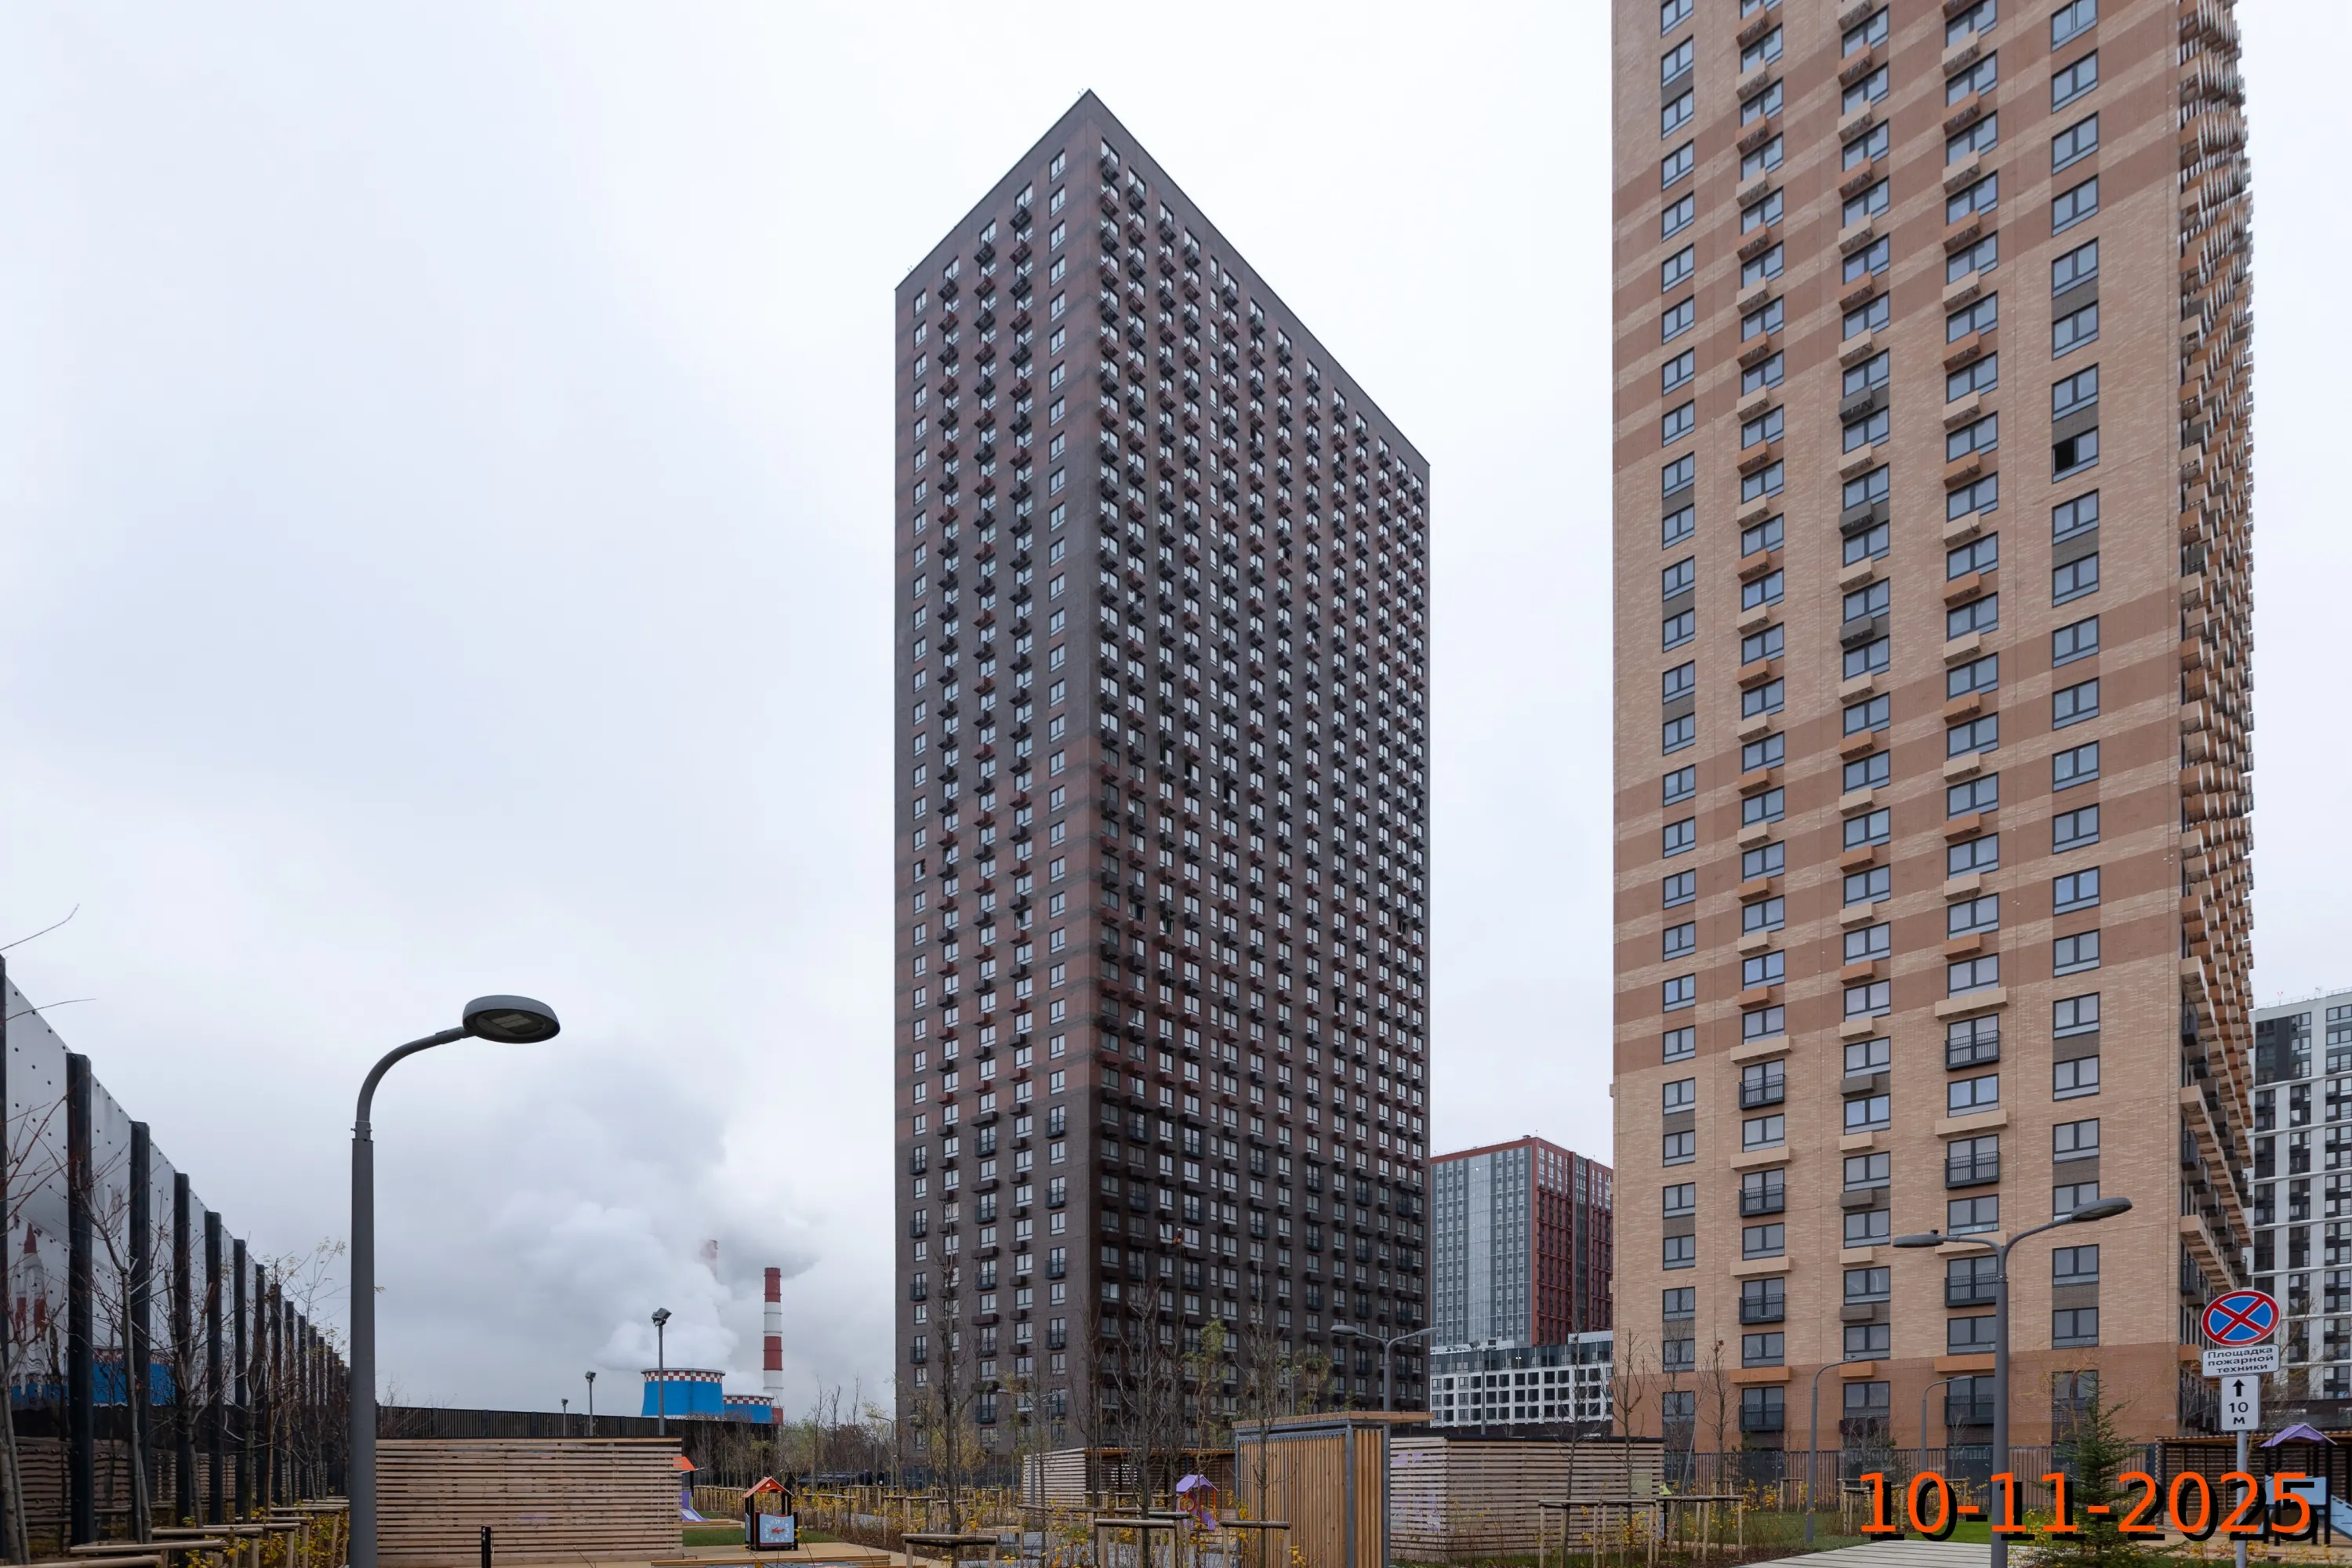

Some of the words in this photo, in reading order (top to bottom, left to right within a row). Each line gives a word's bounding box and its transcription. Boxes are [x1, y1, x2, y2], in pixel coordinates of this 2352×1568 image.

[2208, 1347, 2274, 1359] Площадка
[2208, 1353, 2274, 1367] пожарной
[2216, 1364, 2268, 1374] техники
[2228, 1401, 2249, 1414] 10
